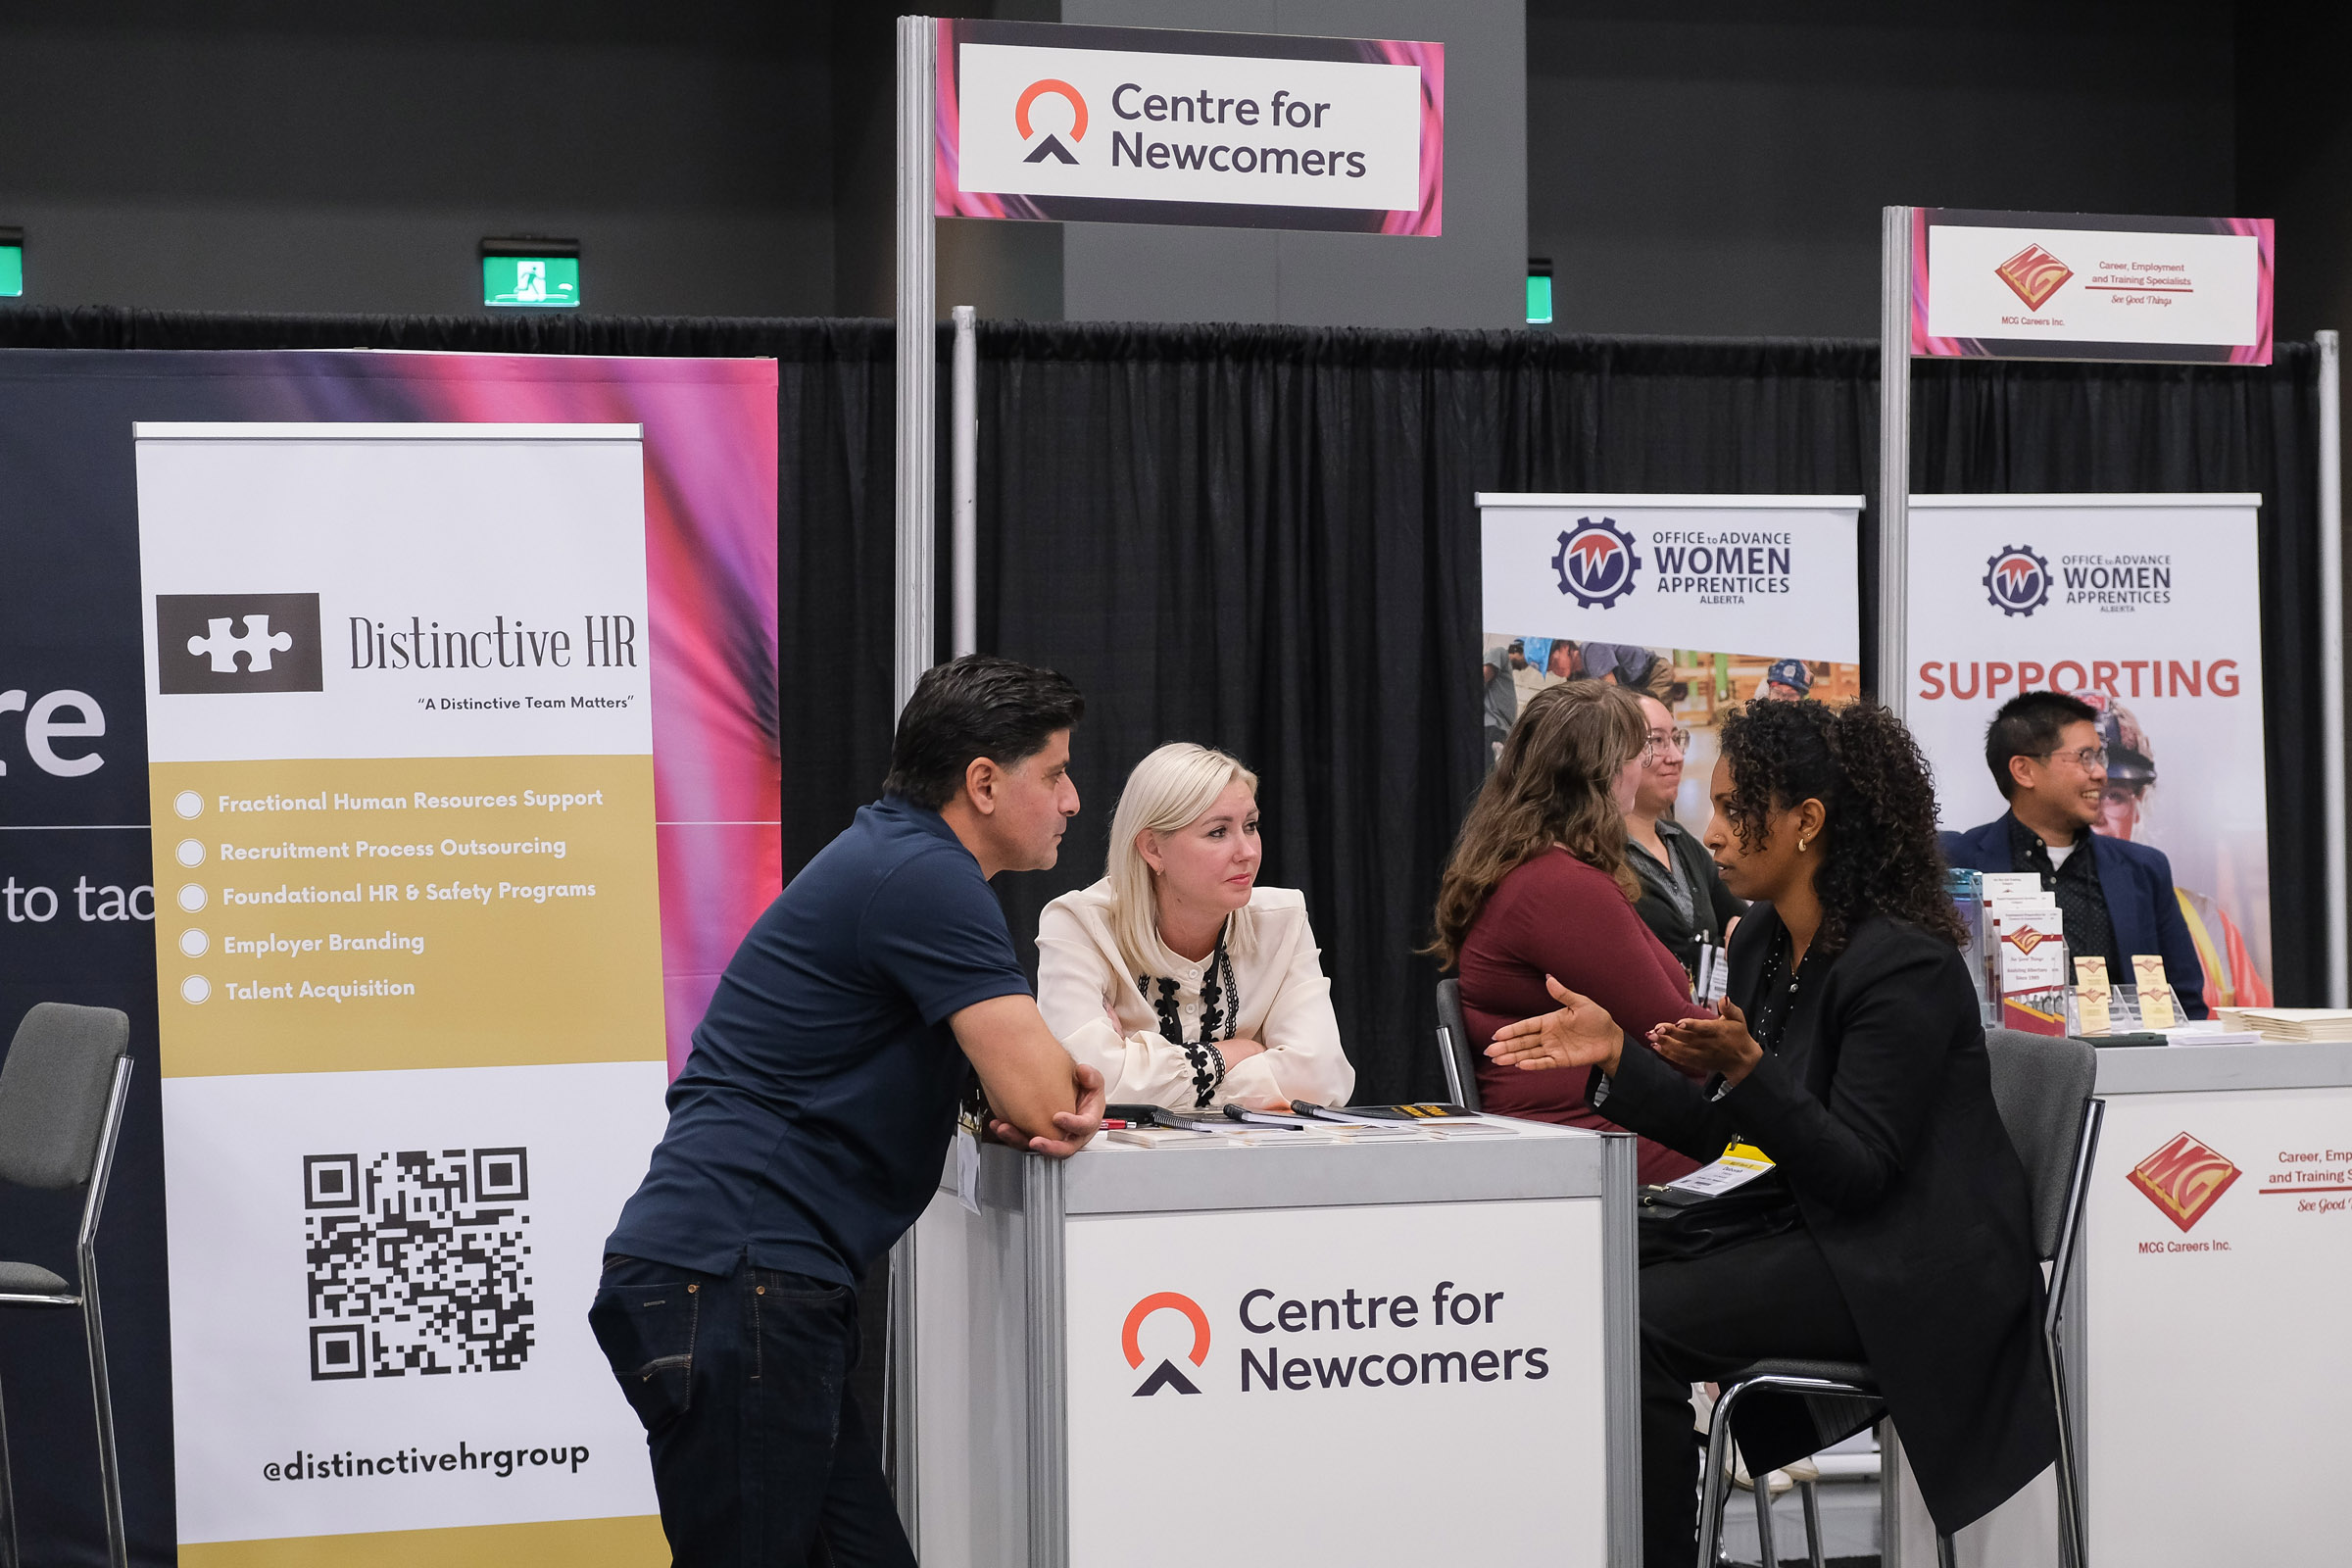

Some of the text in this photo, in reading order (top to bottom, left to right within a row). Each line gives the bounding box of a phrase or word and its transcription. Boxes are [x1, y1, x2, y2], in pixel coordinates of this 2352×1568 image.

[1111, 82, 1331, 128] Centre for
[1111, 130, 1367, 178] Newcomers
[2099, 261, 2184, 272] Career, Employment
[2111, 274, 2144, 285] Training
[2146, 277, 2191, 286] Specialists
[2126, 295, 2144, 306] Good
[2021, 317, 2051, 326] Careers
[2052, 318, 2066, 326] Inc.
[1652, 531, 1791, 545] OFFICE to ADVANCE
[1654, 546, 1790, 575] WOMEN
[2062, 555, 2103, 565] OFFICE
[2115, 555, 2171, 565] ADVANCE
[1657, 577, 1790, 594] APPRENTICES
[2064, 567, 2171, 589] WOMEN
[1699, 595, 1745, 605] ALBERTA
[2066, 590, 2171, 604] APPRENTICES
[349, 614, 638, 669] Distinctive HR
[1919, 659, 2240, 701] SUPPORTING
[440, 696, 521, 710] Distinctive
[525, 696, 566, 709] Team
[219, 789, 604, 813] Fractional Human Resources Support
[220, 836, 566, 861] Recruitment Process Outsourcing
[2, 876, 59, 923] to
[222, 881, 597, 906] Foundational HR & Safety Programs
[224, 930, 424, 958] Employer Branding
[225, 979, 416, 1004] Talent Acquisition
[2278, 1150, 2352, 1163] Career, Emp
[2269, 1170, 2292, 1184] and
[2295, 1169, 2344, 1184] Training
[2297, 1200, 2317, 1212] See
[2319, 1199, 2346, 1214] Good
[2138, 1240, 2231, 1254] MCG Careers Inc.
[1239, 1281, 1504, 1335] Centre for
[1241, 1345, 1549, 1393] Newcomers
[263, 1442, 591, 1482] @distinctivehrgroup
